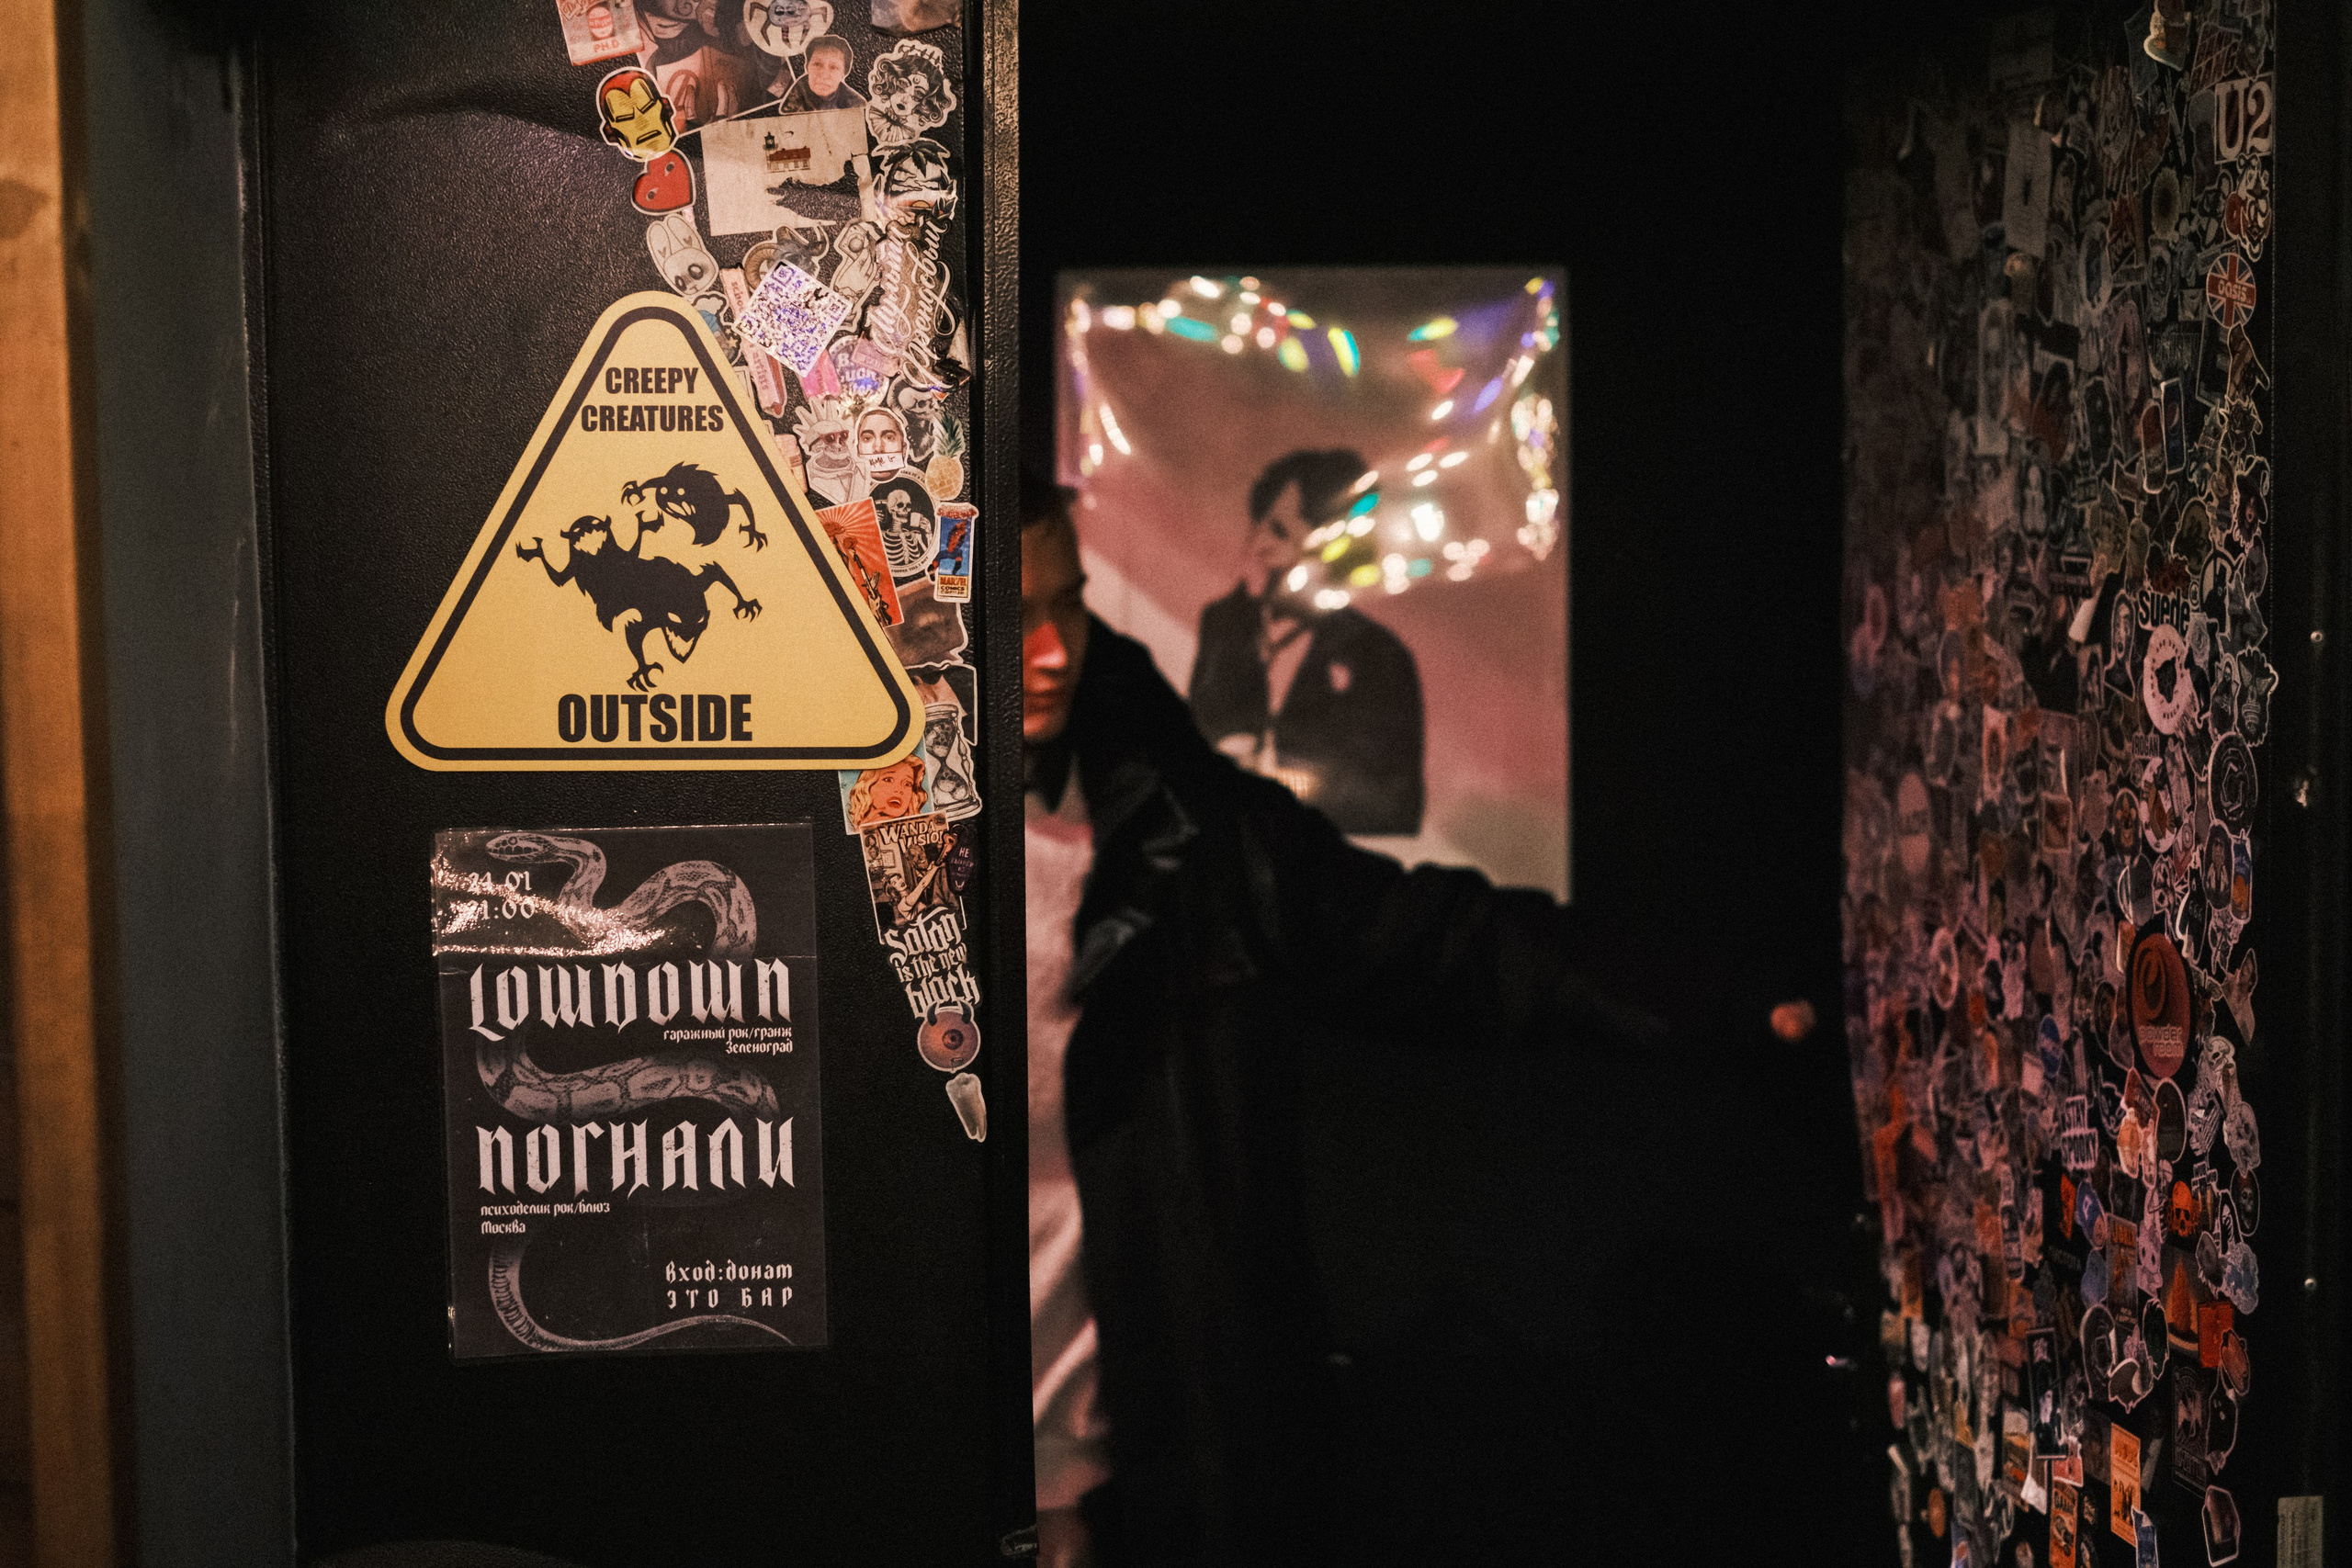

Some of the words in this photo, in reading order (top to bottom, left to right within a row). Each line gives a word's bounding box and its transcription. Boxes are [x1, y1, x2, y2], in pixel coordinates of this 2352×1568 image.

[2215, 78, 2274, 160] U2
[605, 367, 699, 395] CREEPY
[581, 404, 724, 432] CREATURES
[558, 693, 752, 743] OUTSIDE
[879, 820, 935, 845] WANDA
[912, 953, 938, 979] the
[663, 1026, 726, 1043] гаражный
[725, 1038, 793, 1055] Зеленоград
[481, 1218, 526, 1235] Москва
[667, 1288, 718, 1310] ЭТО
[741, 1286, 793, 1308] БАР
